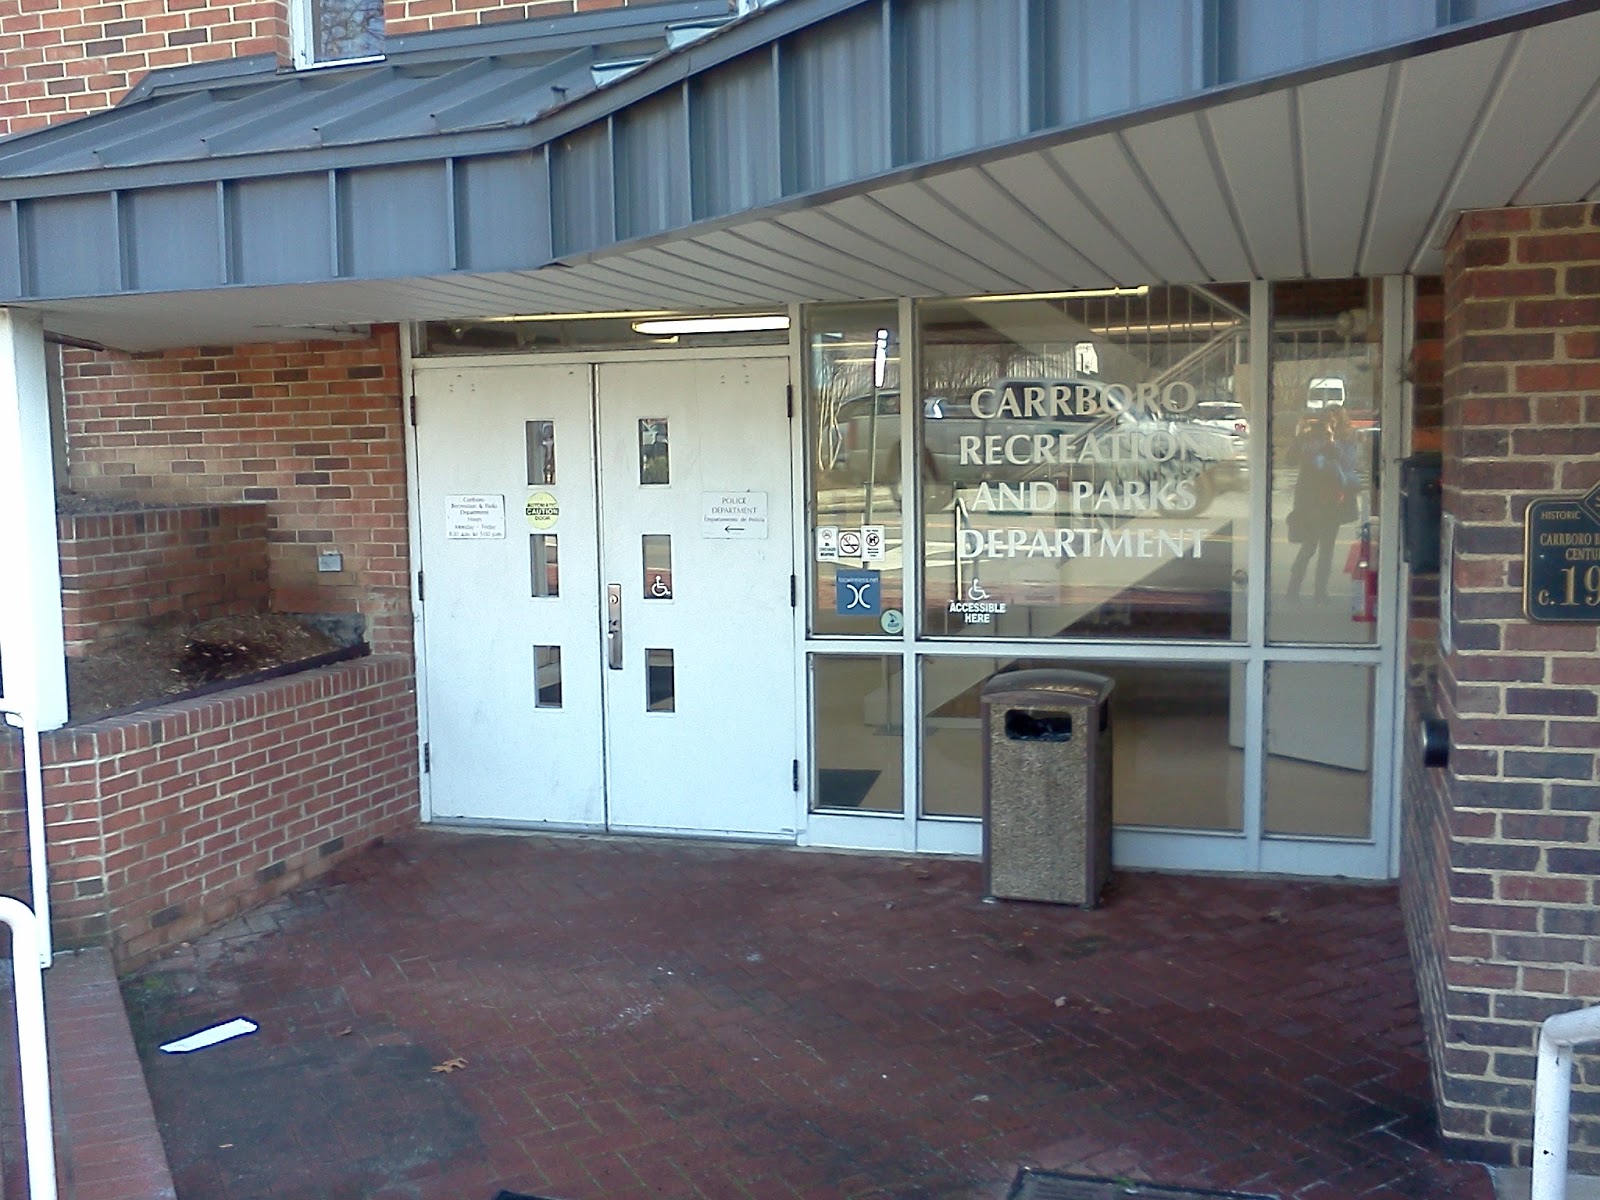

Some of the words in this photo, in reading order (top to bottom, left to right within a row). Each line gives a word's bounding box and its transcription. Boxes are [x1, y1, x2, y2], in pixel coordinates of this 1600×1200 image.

[969, 381, 1197, 420] CARRBORO
[959, 431, 1208, 466] RECREATION
[721, 497, 747, 505] POLICE
[971, 481, 1058, 512] AND
[1072, 480, 1197, 512] PARKS
[711, 506, 757, 514] DEPARTMENT
[1541, 510, 1581, 520] HISTORIC
[957, 528, 1209, 559] DEPARTMENT
[1540, 532, 1592, 546] CARRBORO
[949, 601, 1006, 613] ACCESSIBLE
[964, 613, 990, 623] HERE
